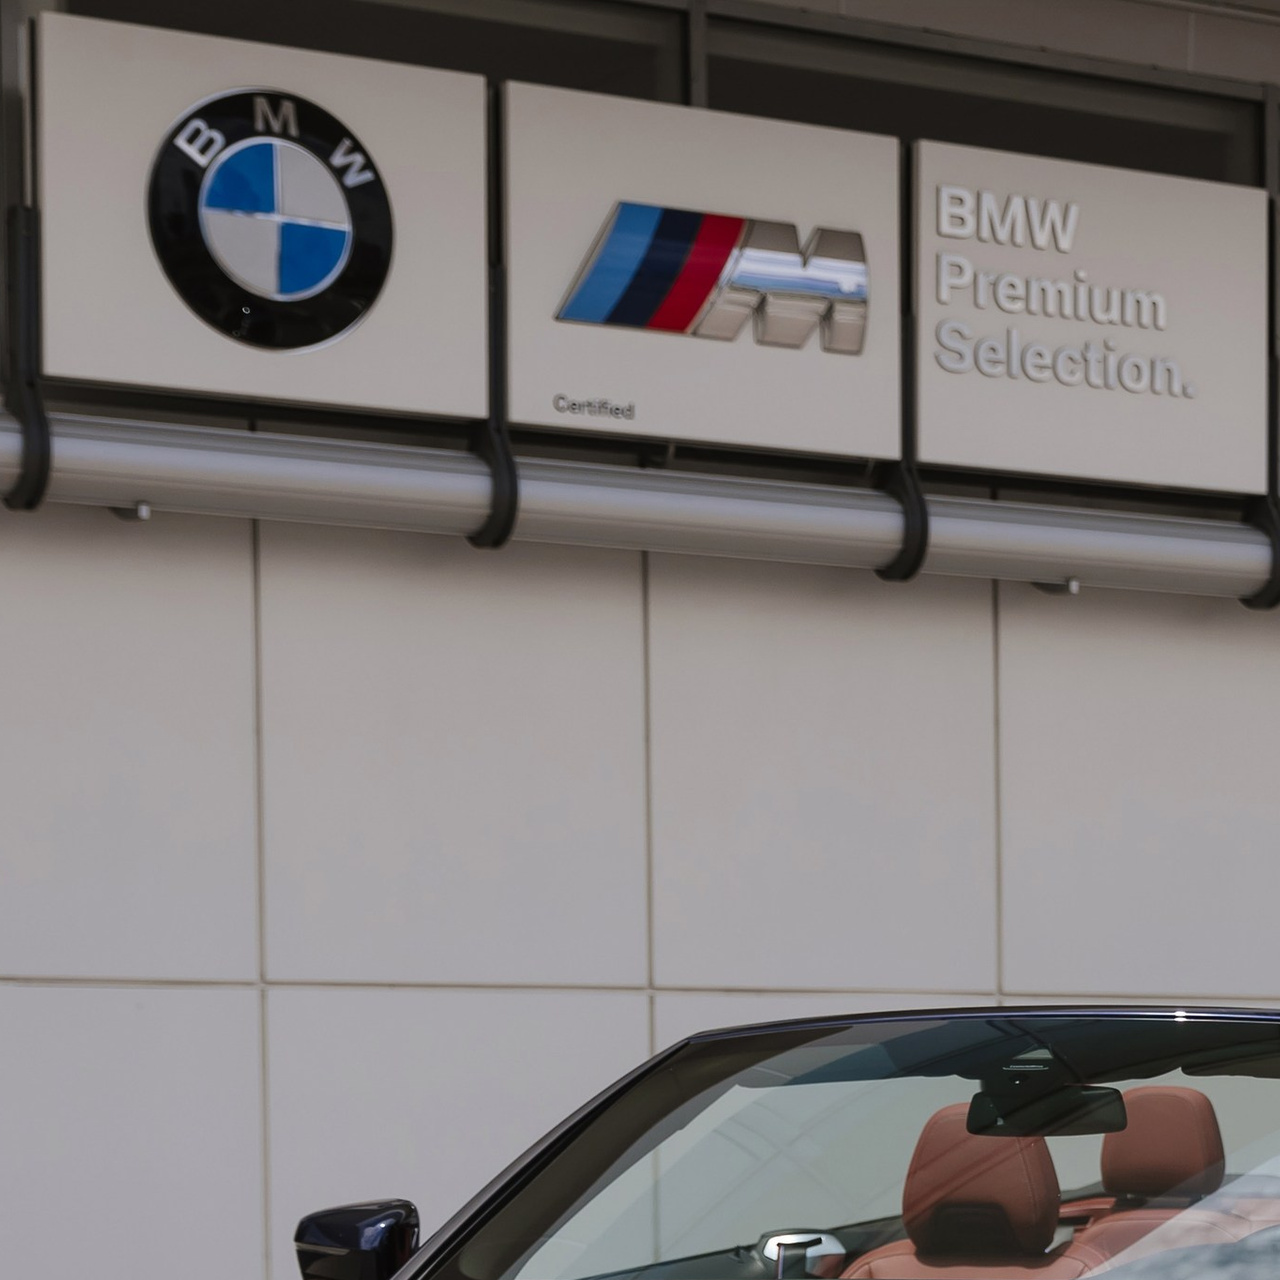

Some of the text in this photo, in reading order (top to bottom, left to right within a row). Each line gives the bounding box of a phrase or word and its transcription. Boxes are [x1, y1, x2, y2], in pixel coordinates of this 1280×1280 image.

[173, 96, 376, 189] BMW
[937, 185, 1079, 252] BMW
[936, 253, 1167, 331] Premium
[934, 317, 1195, 399] Selection.
